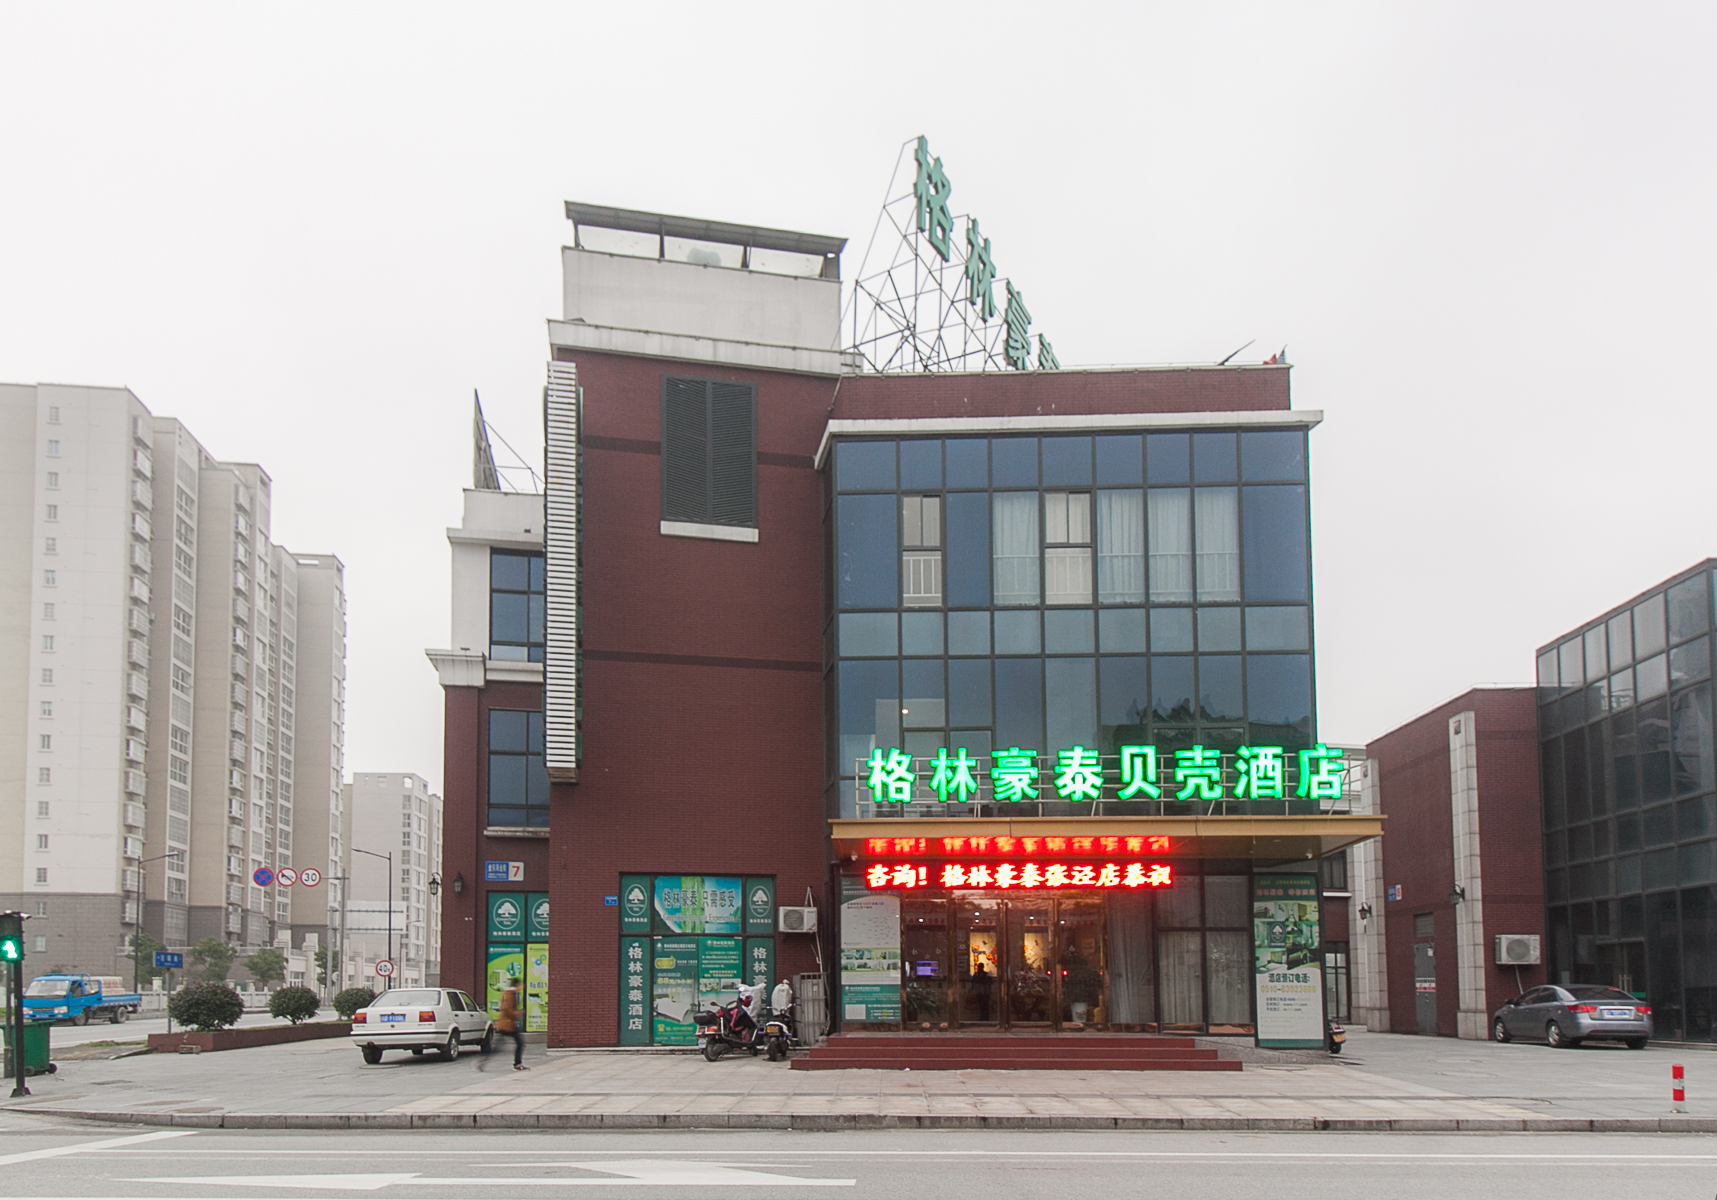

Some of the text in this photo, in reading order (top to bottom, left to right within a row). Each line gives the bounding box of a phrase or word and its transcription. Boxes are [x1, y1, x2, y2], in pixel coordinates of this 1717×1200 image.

[866, 743, 1345, 804] 格林豪泰贝壳酒店
[303, 872, 318, 882] 30
[511, 865, 520, 878] 7
[1268, 973, 1310, 983] 酒店预订电话:
[628, 947, 643, 1031] 格林豪泰酒店
